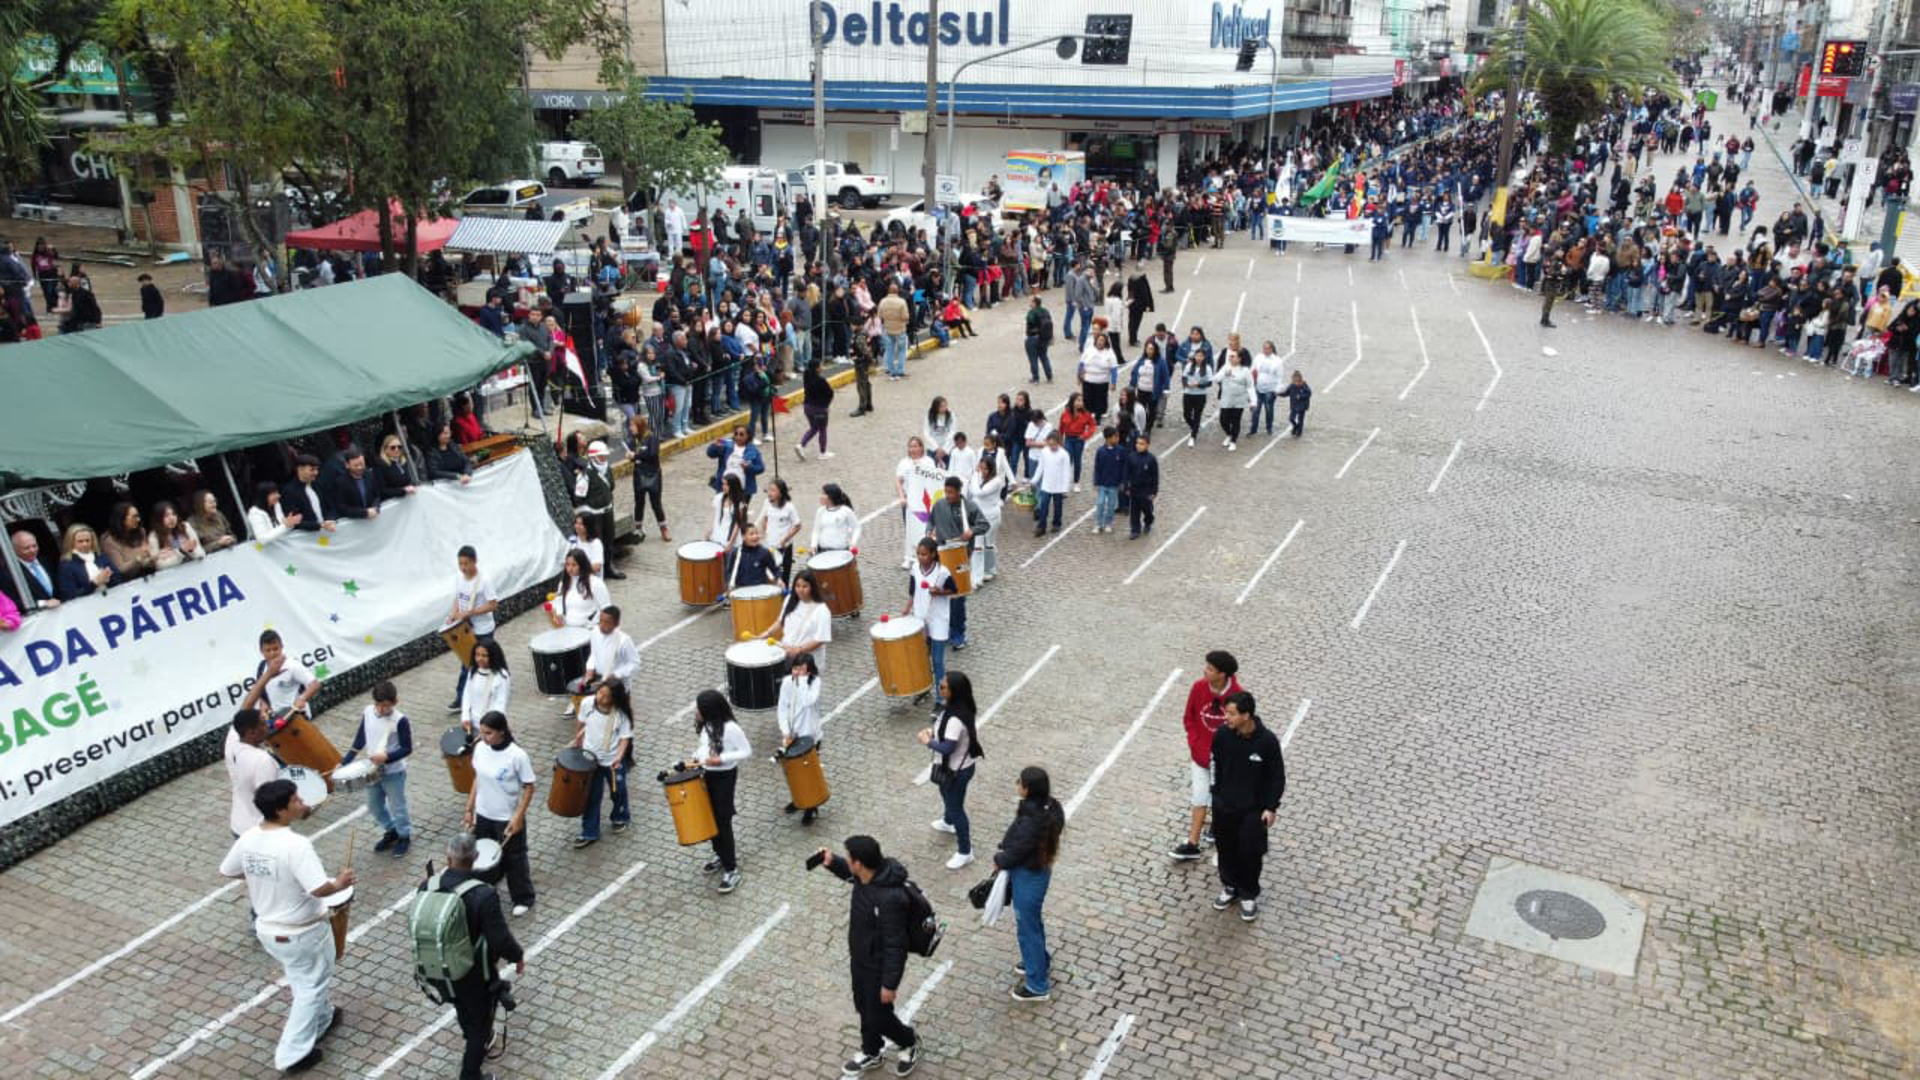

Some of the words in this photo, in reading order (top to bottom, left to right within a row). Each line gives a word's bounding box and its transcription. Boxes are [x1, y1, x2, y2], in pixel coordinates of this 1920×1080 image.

[810, 0, 1009, 48] Deltasul
[541, 95, 576, 108] YORK
[24, 627, 99, 678] DA
[99, 574, 247, 650] PÁTRIA
[24, 719, 156, 796] preservar
[163, 691, 222, 734] para
